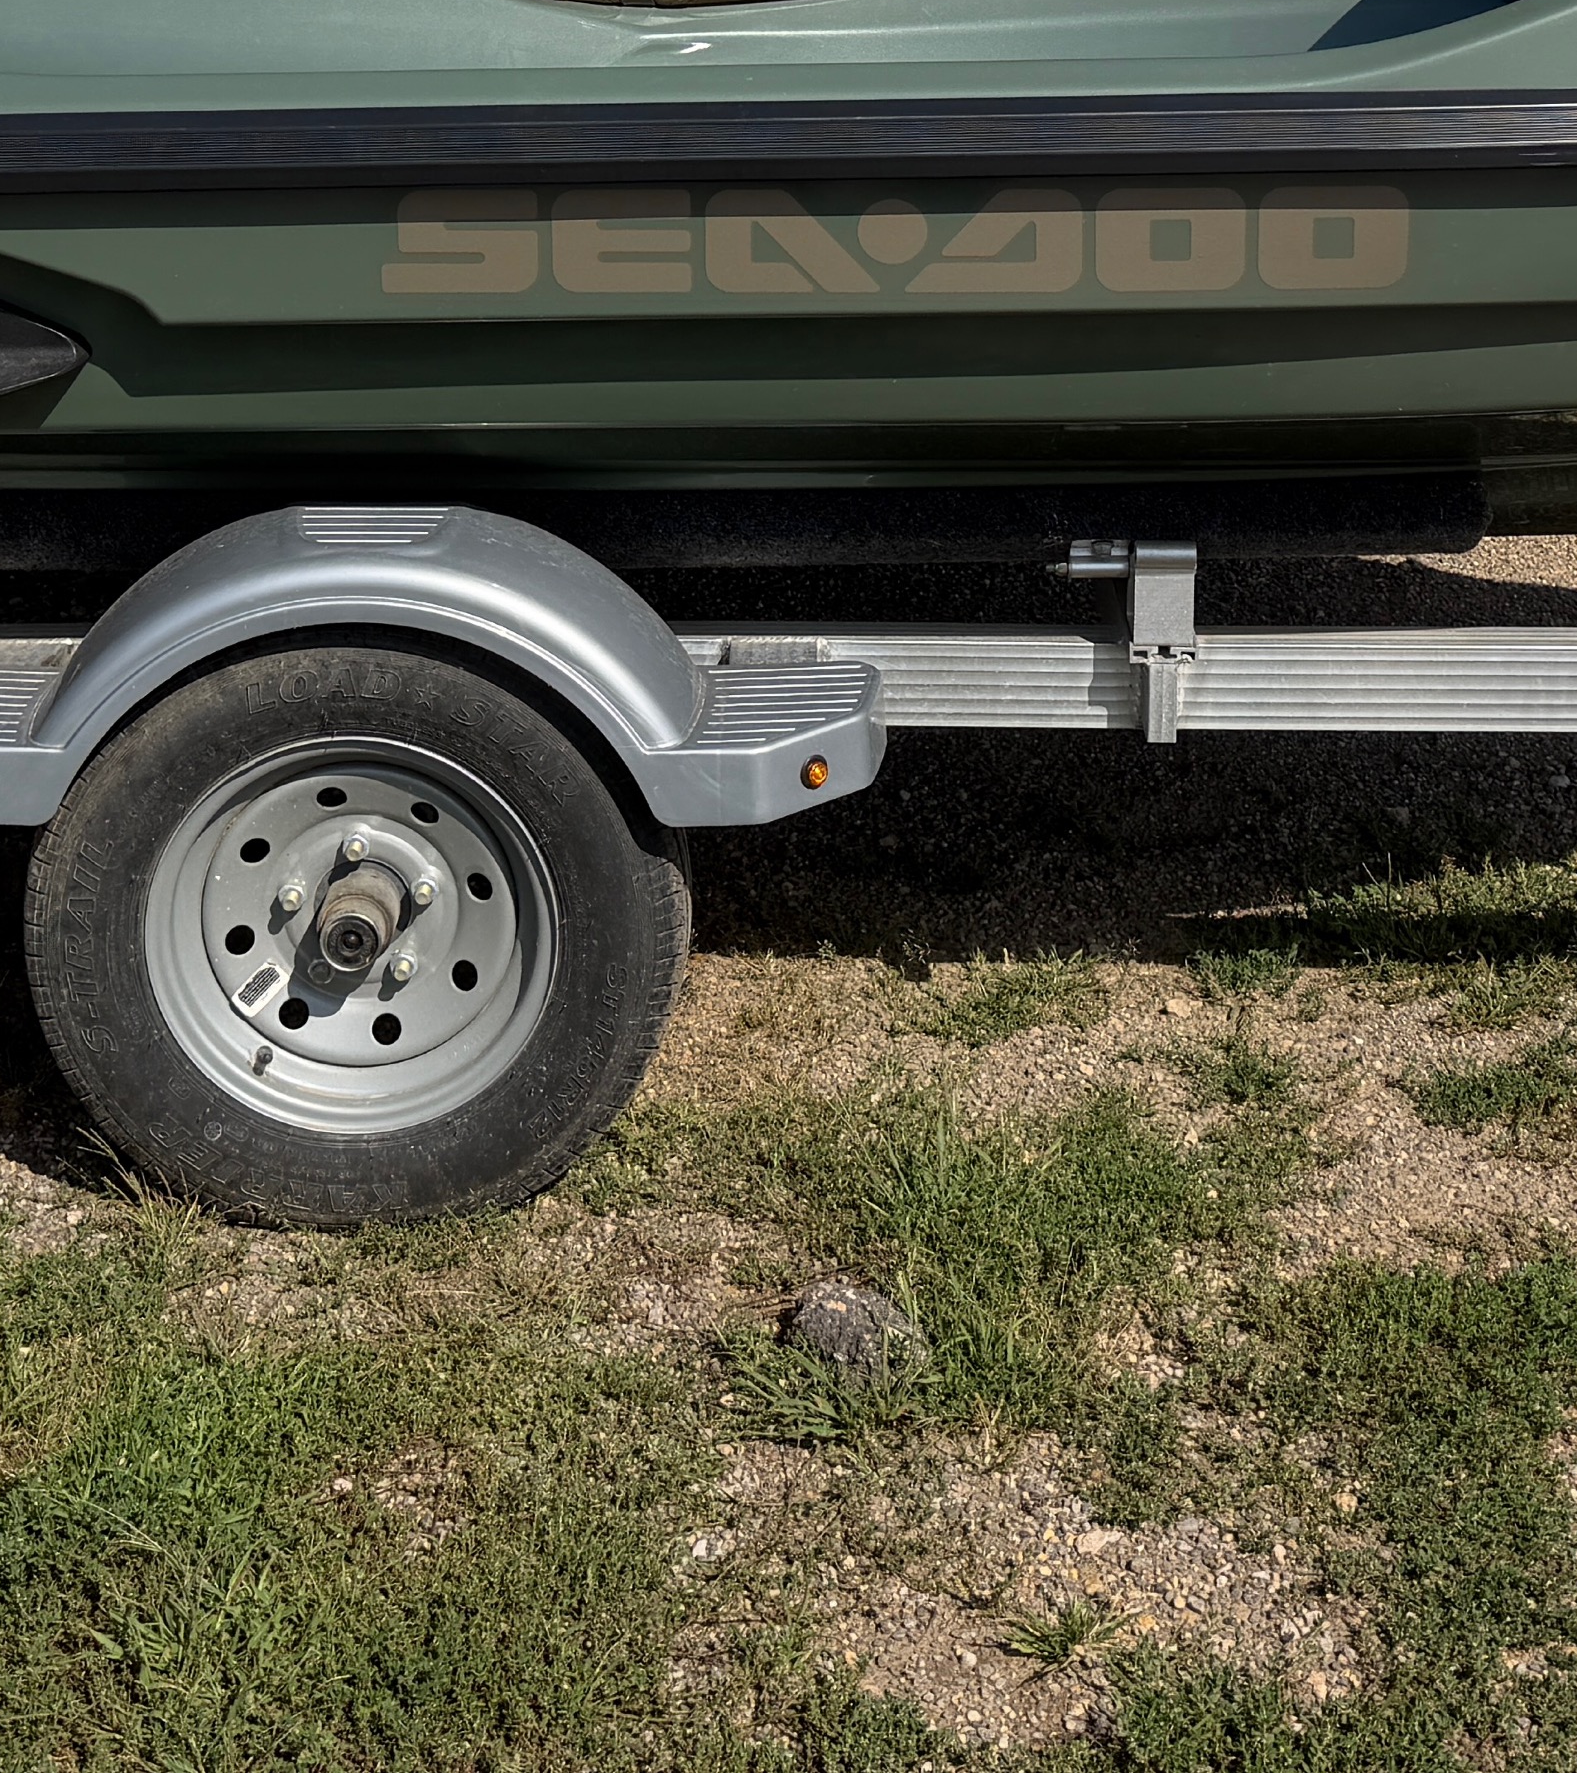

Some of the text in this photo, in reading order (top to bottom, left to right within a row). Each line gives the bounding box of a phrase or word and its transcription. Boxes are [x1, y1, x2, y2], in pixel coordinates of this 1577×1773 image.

[246, 666, 580, 807] LOAD STAR
[64, 840, 119, 1053] S-TRAIL
